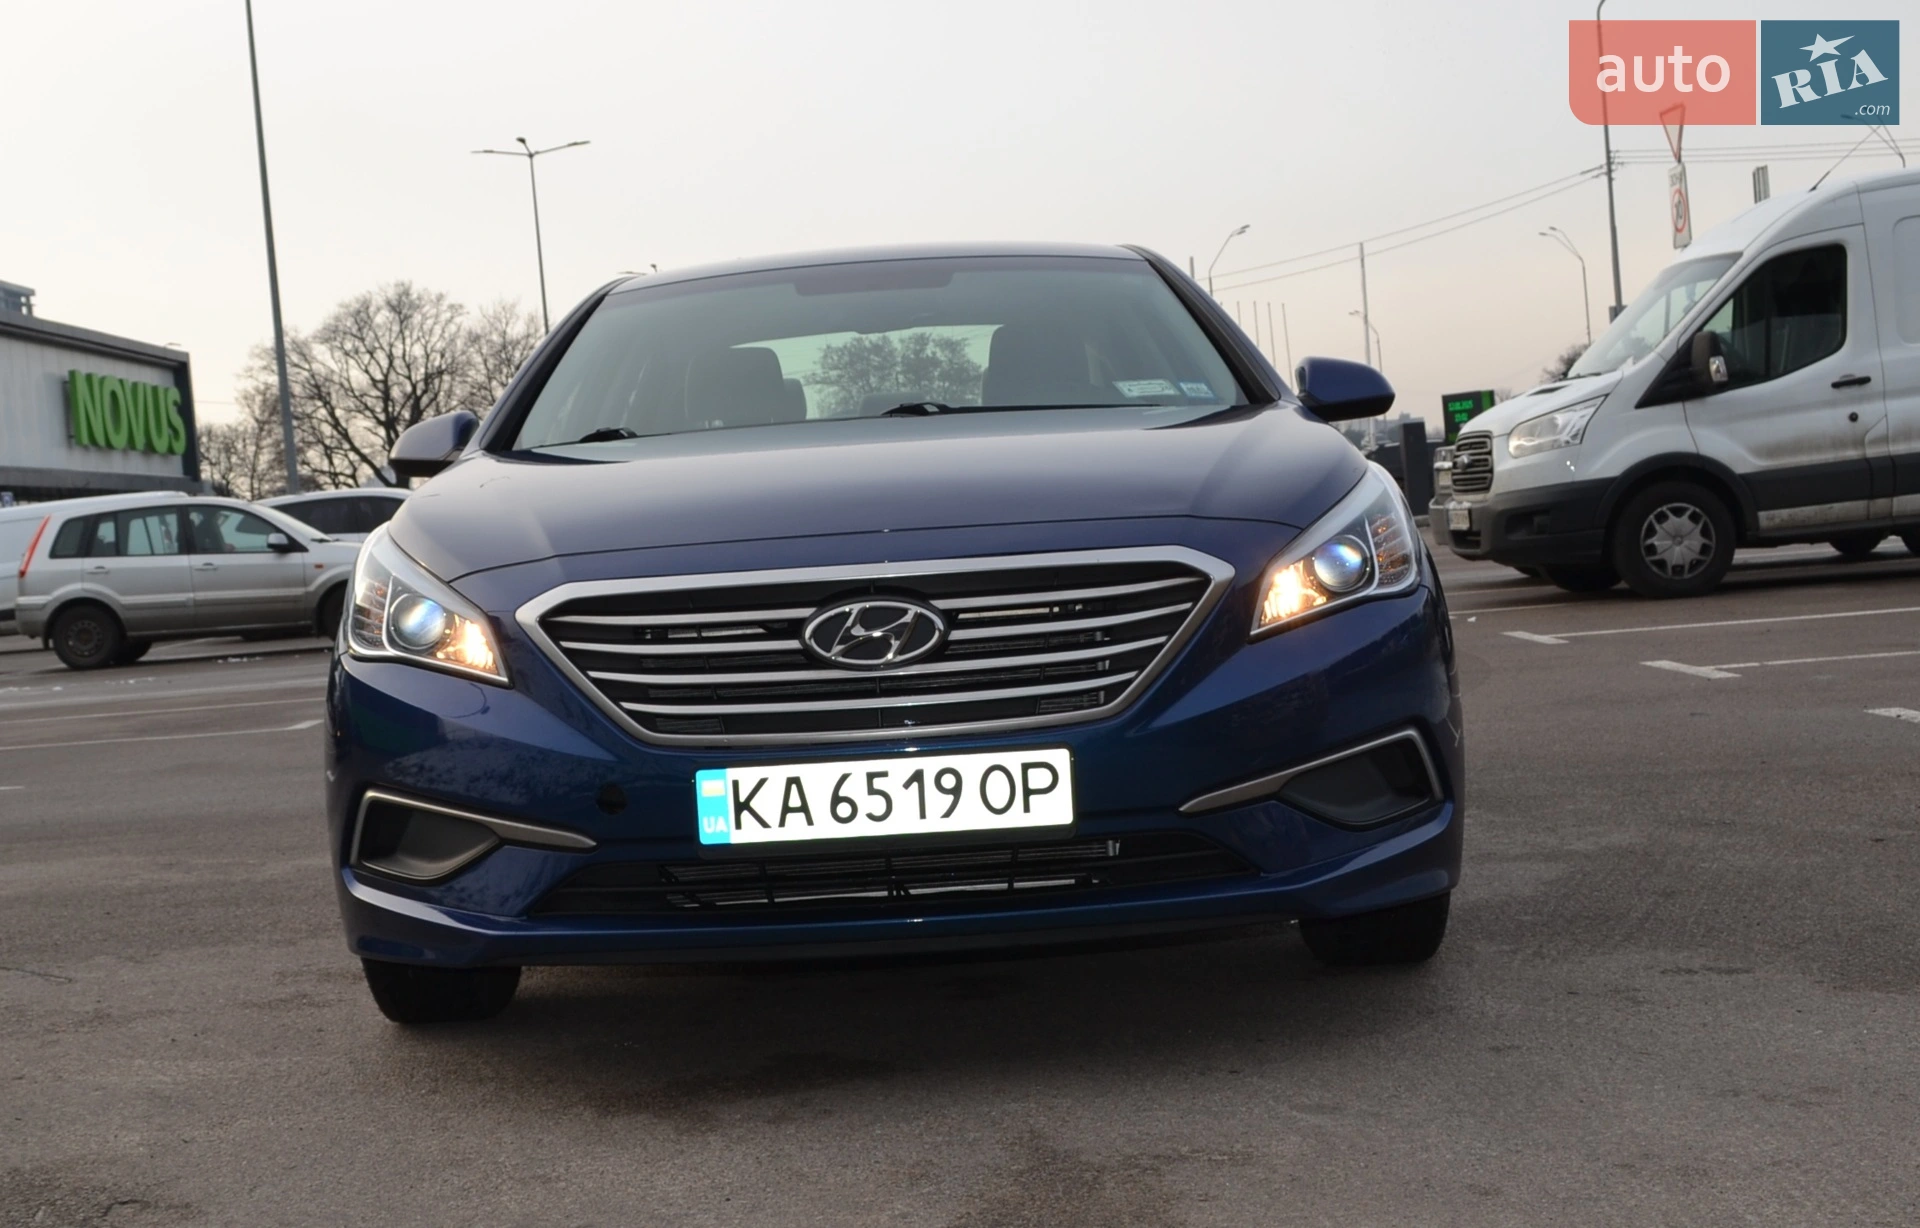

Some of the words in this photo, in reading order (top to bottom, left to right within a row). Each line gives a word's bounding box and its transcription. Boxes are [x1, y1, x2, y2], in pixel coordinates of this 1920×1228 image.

[68, 369, 186, 456] NOVUS
[703, 816, 729, 833] UA
[732, 776, 814, 831] KA
[829, 766, 963, 824] 6519
[979, 761, 1059, 815] OP
